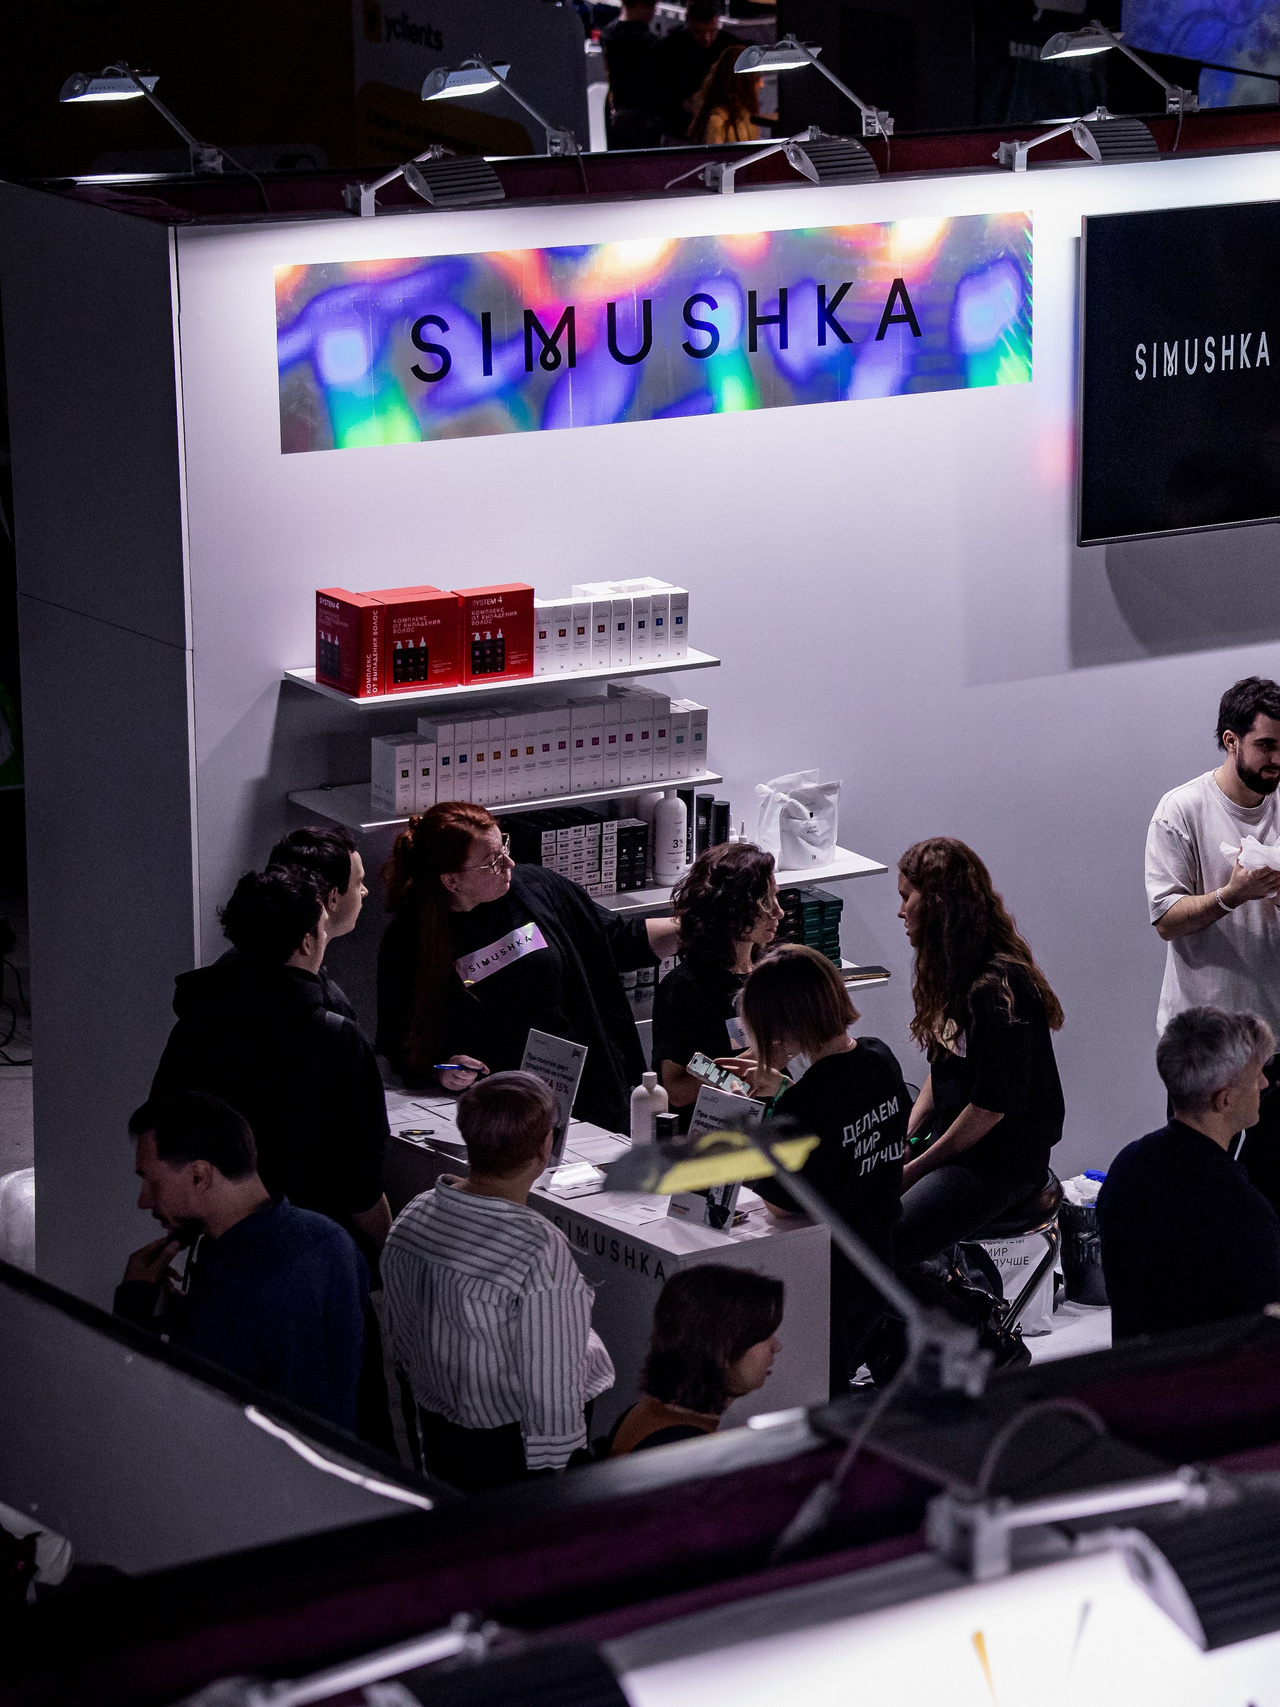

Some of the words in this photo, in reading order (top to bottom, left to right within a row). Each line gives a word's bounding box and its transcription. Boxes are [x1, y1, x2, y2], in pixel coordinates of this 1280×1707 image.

[385, 11, 443, 51] yclients
[410, 277, 923, 383] SIMUSHKA
[1135, 331, 1270, 381] SIMUSHKA
[472, 598, 497, 607] SYSTEM
[471, 607, 505, 616] КОМПЛЕКС
[482, 610, 518, 620] ВЫПАДЕНИЯ
[392, 615, 428, 624] КОМПЛЕКС
[471, 618, 493, 626] ВОЛОС
[392, 627, 415, 635] ВОЛОС
[372, 682, 378, 693] ОТ
[468, 935, 533, 973] SIMUSHKA
[555, 1081, 569, 1094] 15%
[696, 1109, 708, 1119] При
[841, 1096, 900, 1148] ДЕЛАЕМ
[859, 1136, 905, 1176] ЛУЧШ
